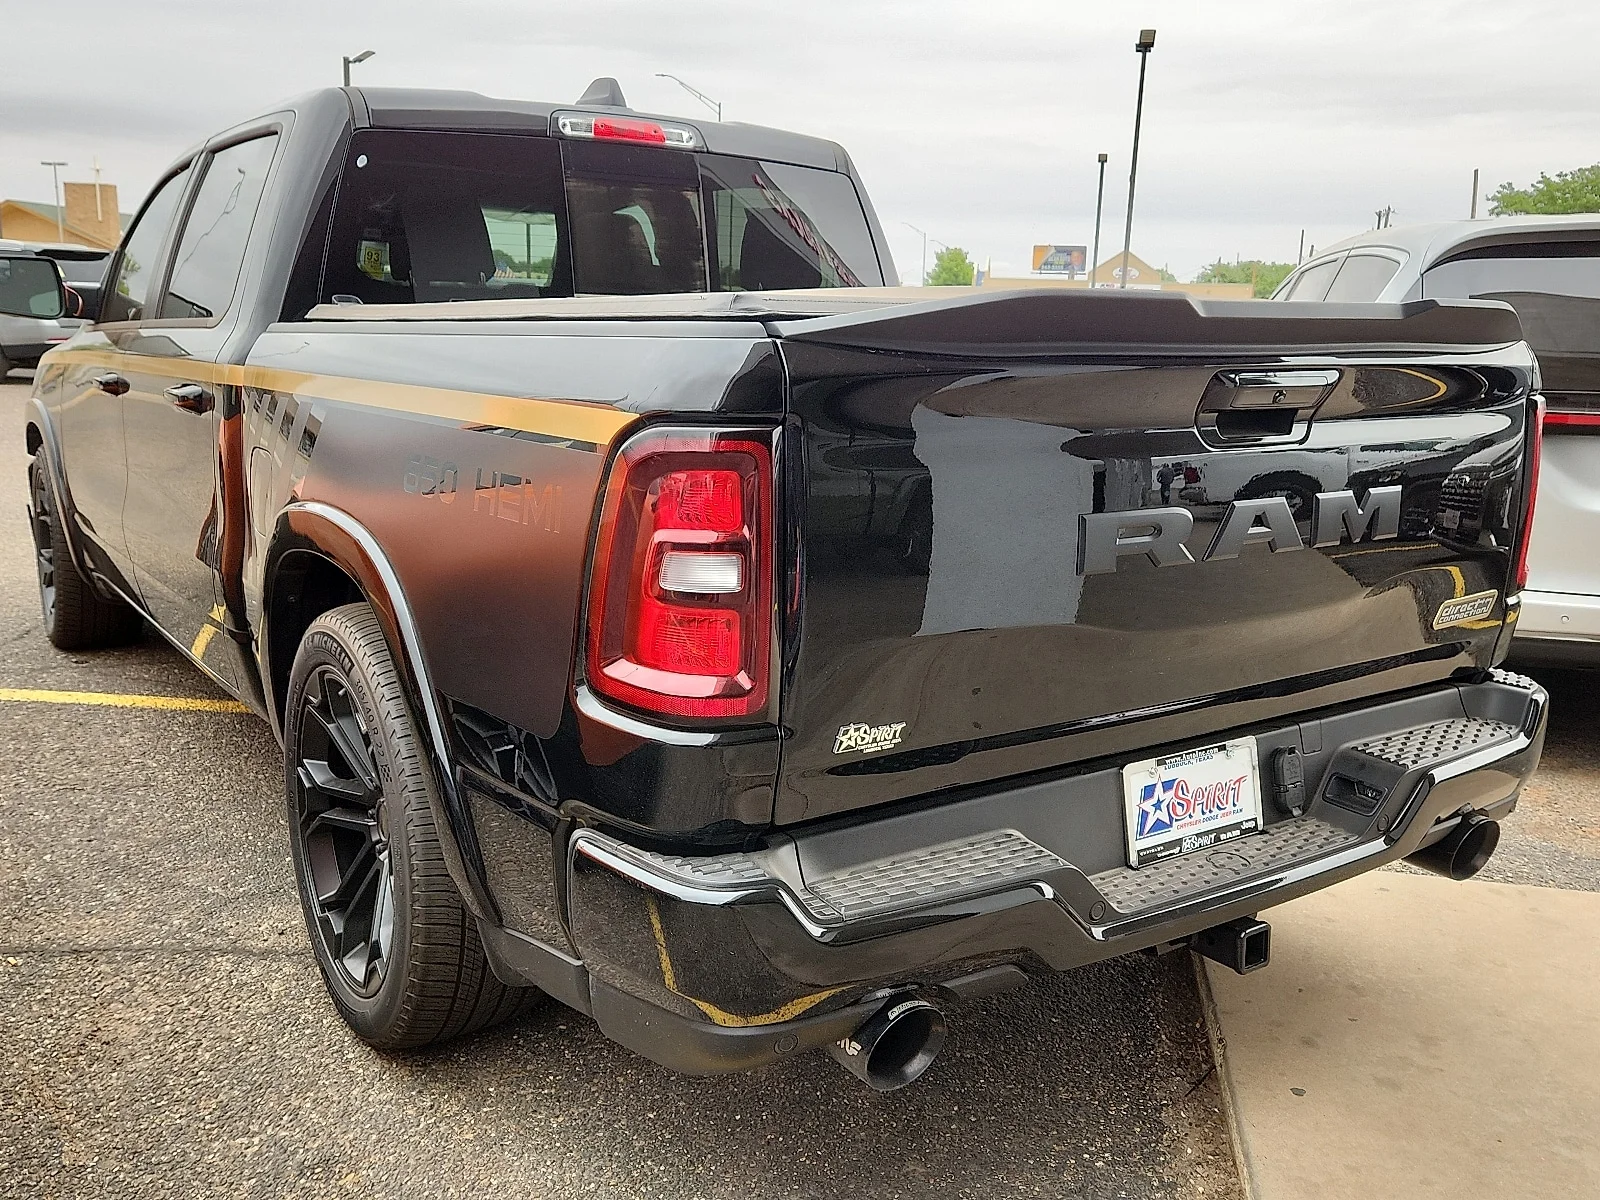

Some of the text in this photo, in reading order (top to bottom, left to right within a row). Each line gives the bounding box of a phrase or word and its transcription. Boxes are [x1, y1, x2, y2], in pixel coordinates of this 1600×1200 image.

[366, 250, 380, 262] 93
[473, 467, 563, 534] HEMI
[1075, 485, 1402, 576] RAM
[313, 634, 352, 673] MICHELIN
[857, 721, 907, 745] SPIRIT
[1171, 775, 1249, 823] SPIRIT
[1176, 807, 1244, 831] CHRYSLER DODGE JEEP RAM
[1189, 832, 1217, 849] SPIRIT
[1220, 830, 1241, 841] RAM
[1240, 820, 1256, 830] Jeep
